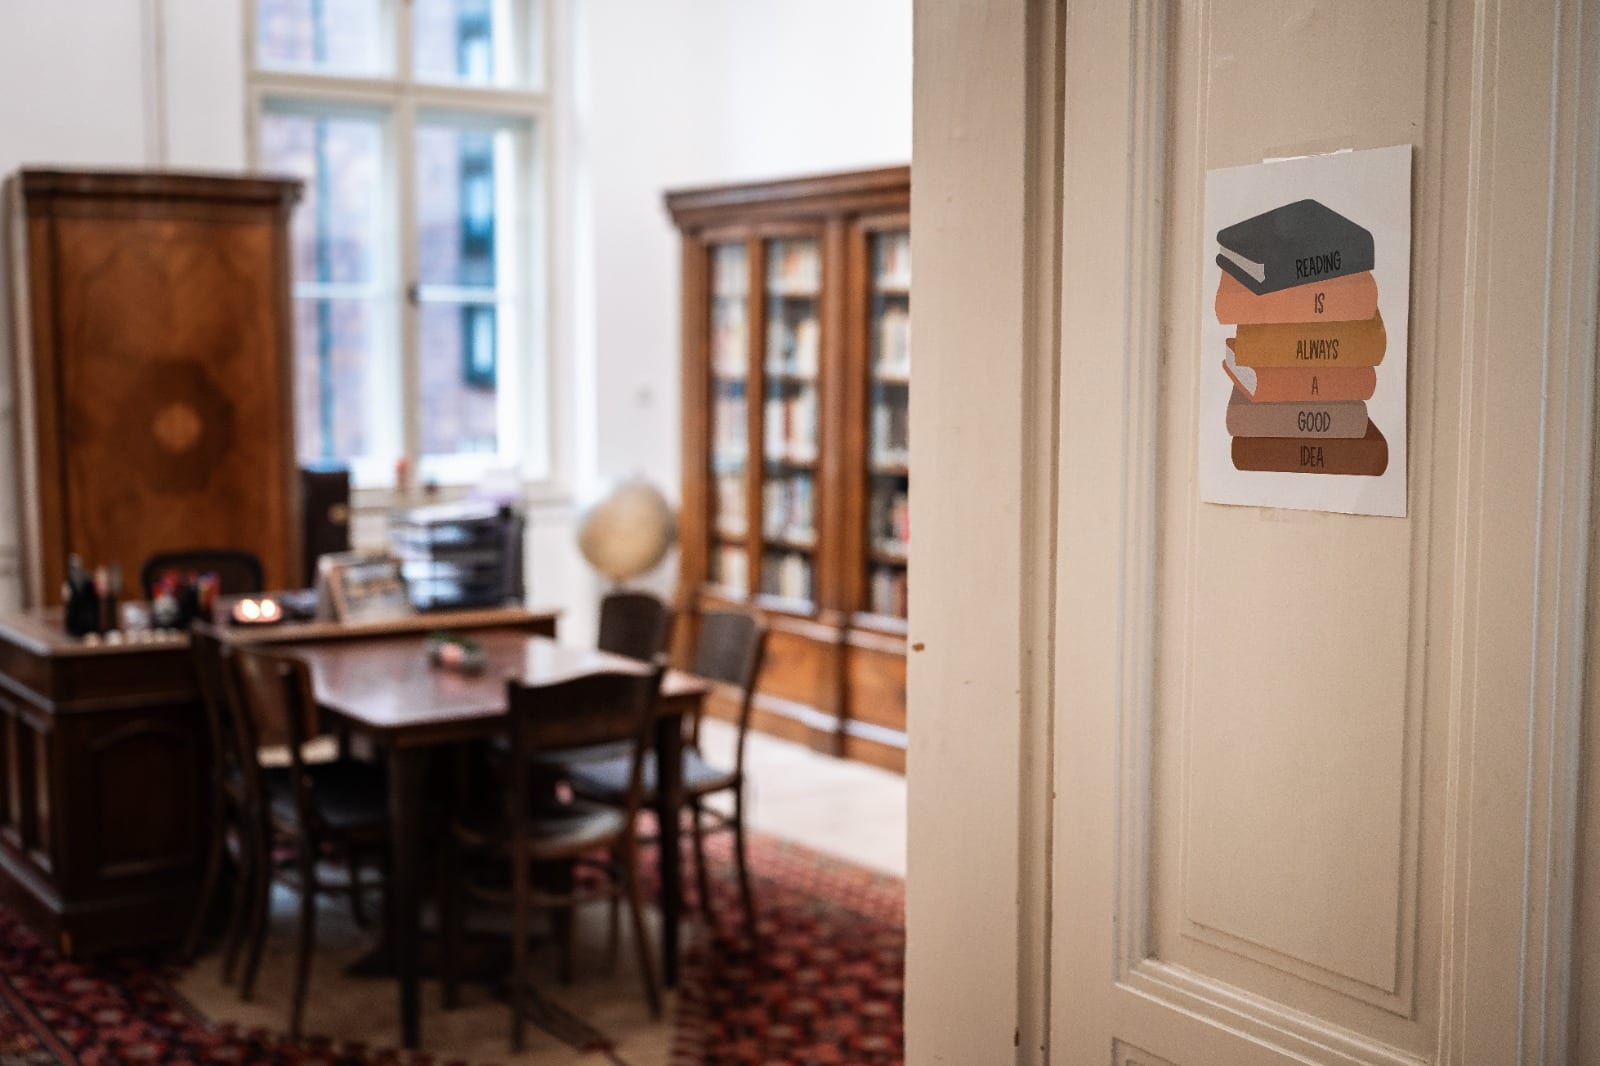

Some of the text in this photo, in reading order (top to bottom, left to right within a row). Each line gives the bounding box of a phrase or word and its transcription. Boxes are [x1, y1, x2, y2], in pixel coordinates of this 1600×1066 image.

[1296, 251, 1341, 278] READING
[1314, 293, 1325, 314] IS
[1296, 339, 1339, 360] ALWAYS
[1311, 376, 1319, 395] A
[1298, 411, 1331, 432] GOOD
[1300, 446, 1324, 468] IDEA
